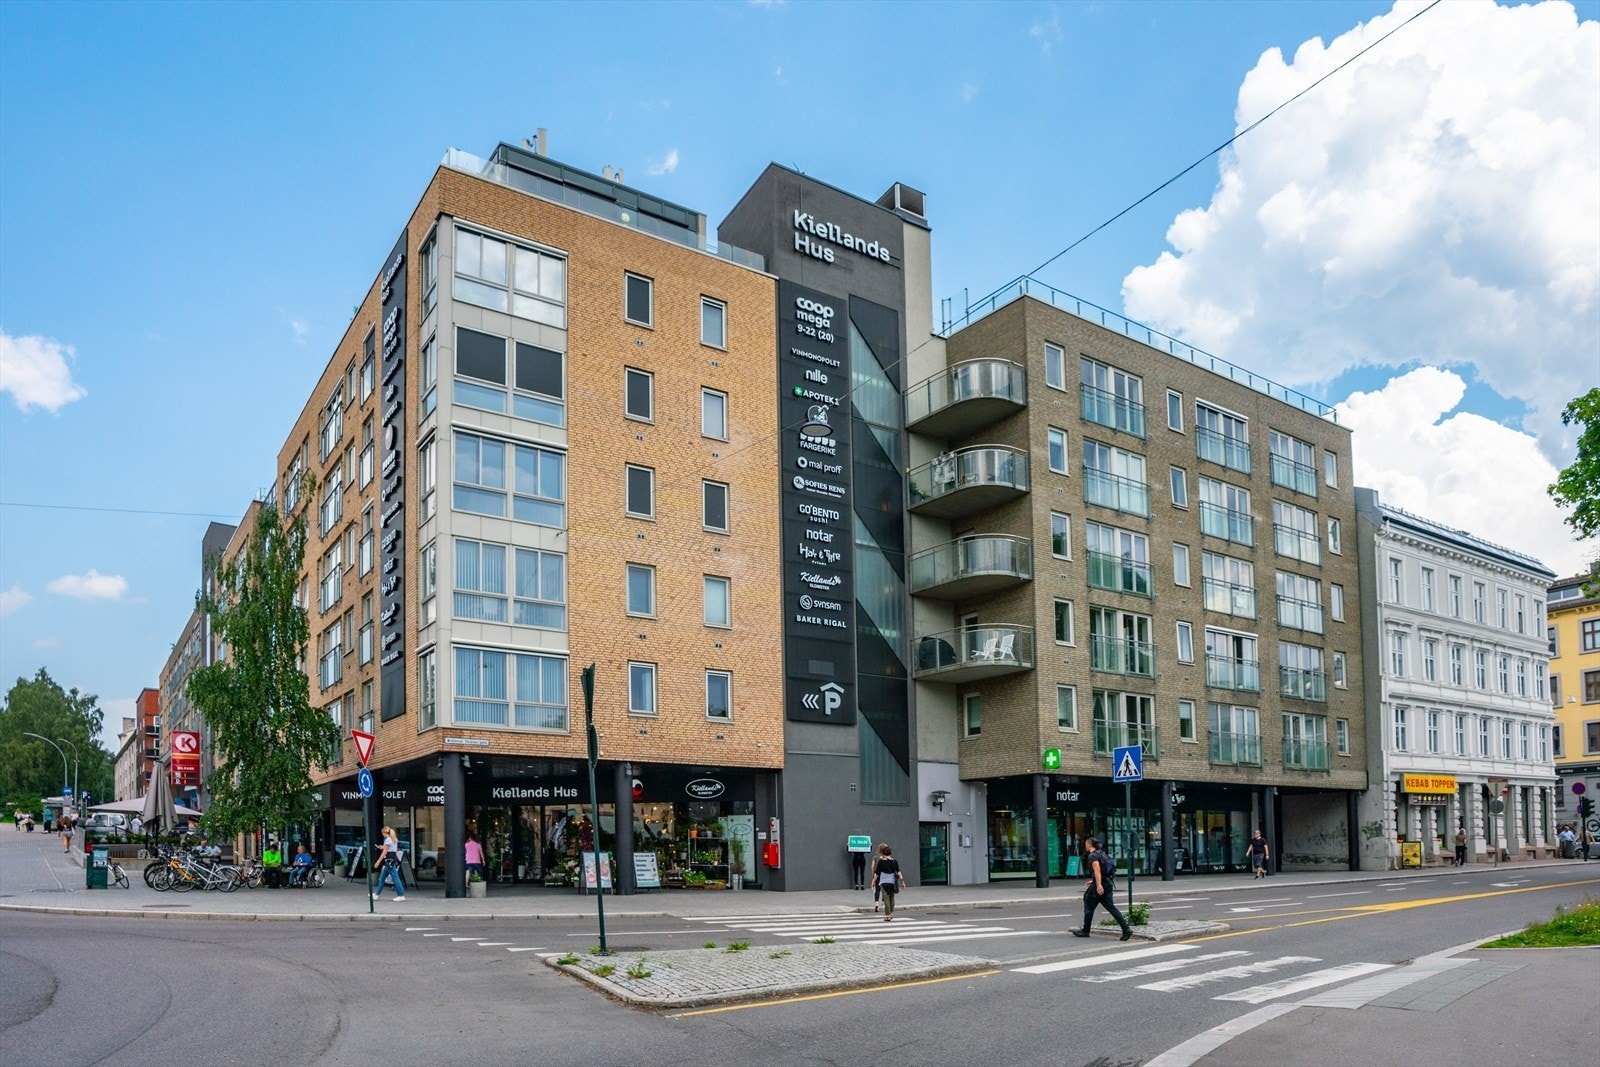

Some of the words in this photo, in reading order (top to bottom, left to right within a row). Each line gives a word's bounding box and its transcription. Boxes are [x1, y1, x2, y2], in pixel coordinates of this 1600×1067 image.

[794, 209, 890, 262] Kiellands
[794, 232, 835, 263] Hus
[796, 297, 834, 318] coop
[384, 306, 398, 334] coop
[797, 310, 830, 328] mega
[797, 324, 816, 337] 9-22
[818, 330, 834, 343] (20)
[791, 347, 840, 368] VINMONOPOLET
[805, 369, 828, 384] nille
[803, 390, 834, 404] APOTEK
[800, 441, 836, 456] FARGERIKE
[808, 459, 822, 470] mal
[824, 464, 843, 474] proff
[804, 479, 828, 491] SOFIES
[829, 485, 845, 495] RENS
[799, 504, 839, 520] GO'BENTO
[810, 516, 828, 524] sushi
[806, 529, 833, 543] notar
[796, 615, 821, 625] BAKER
[824, 618, 847, 628] RIGAL
[825, 691, 841, 715] P
[427, 785, 445, 794] coo
[1405, 778, 1429, 788] KEBAB
[1431, 779, 1455, 789] TOPPEN
[427, 795, 445, 804] meg
[492, 787, 550, 799] Kiellands
[553, 786, 578, 798] Hus
[1056, 789, 1080, 801] notar
